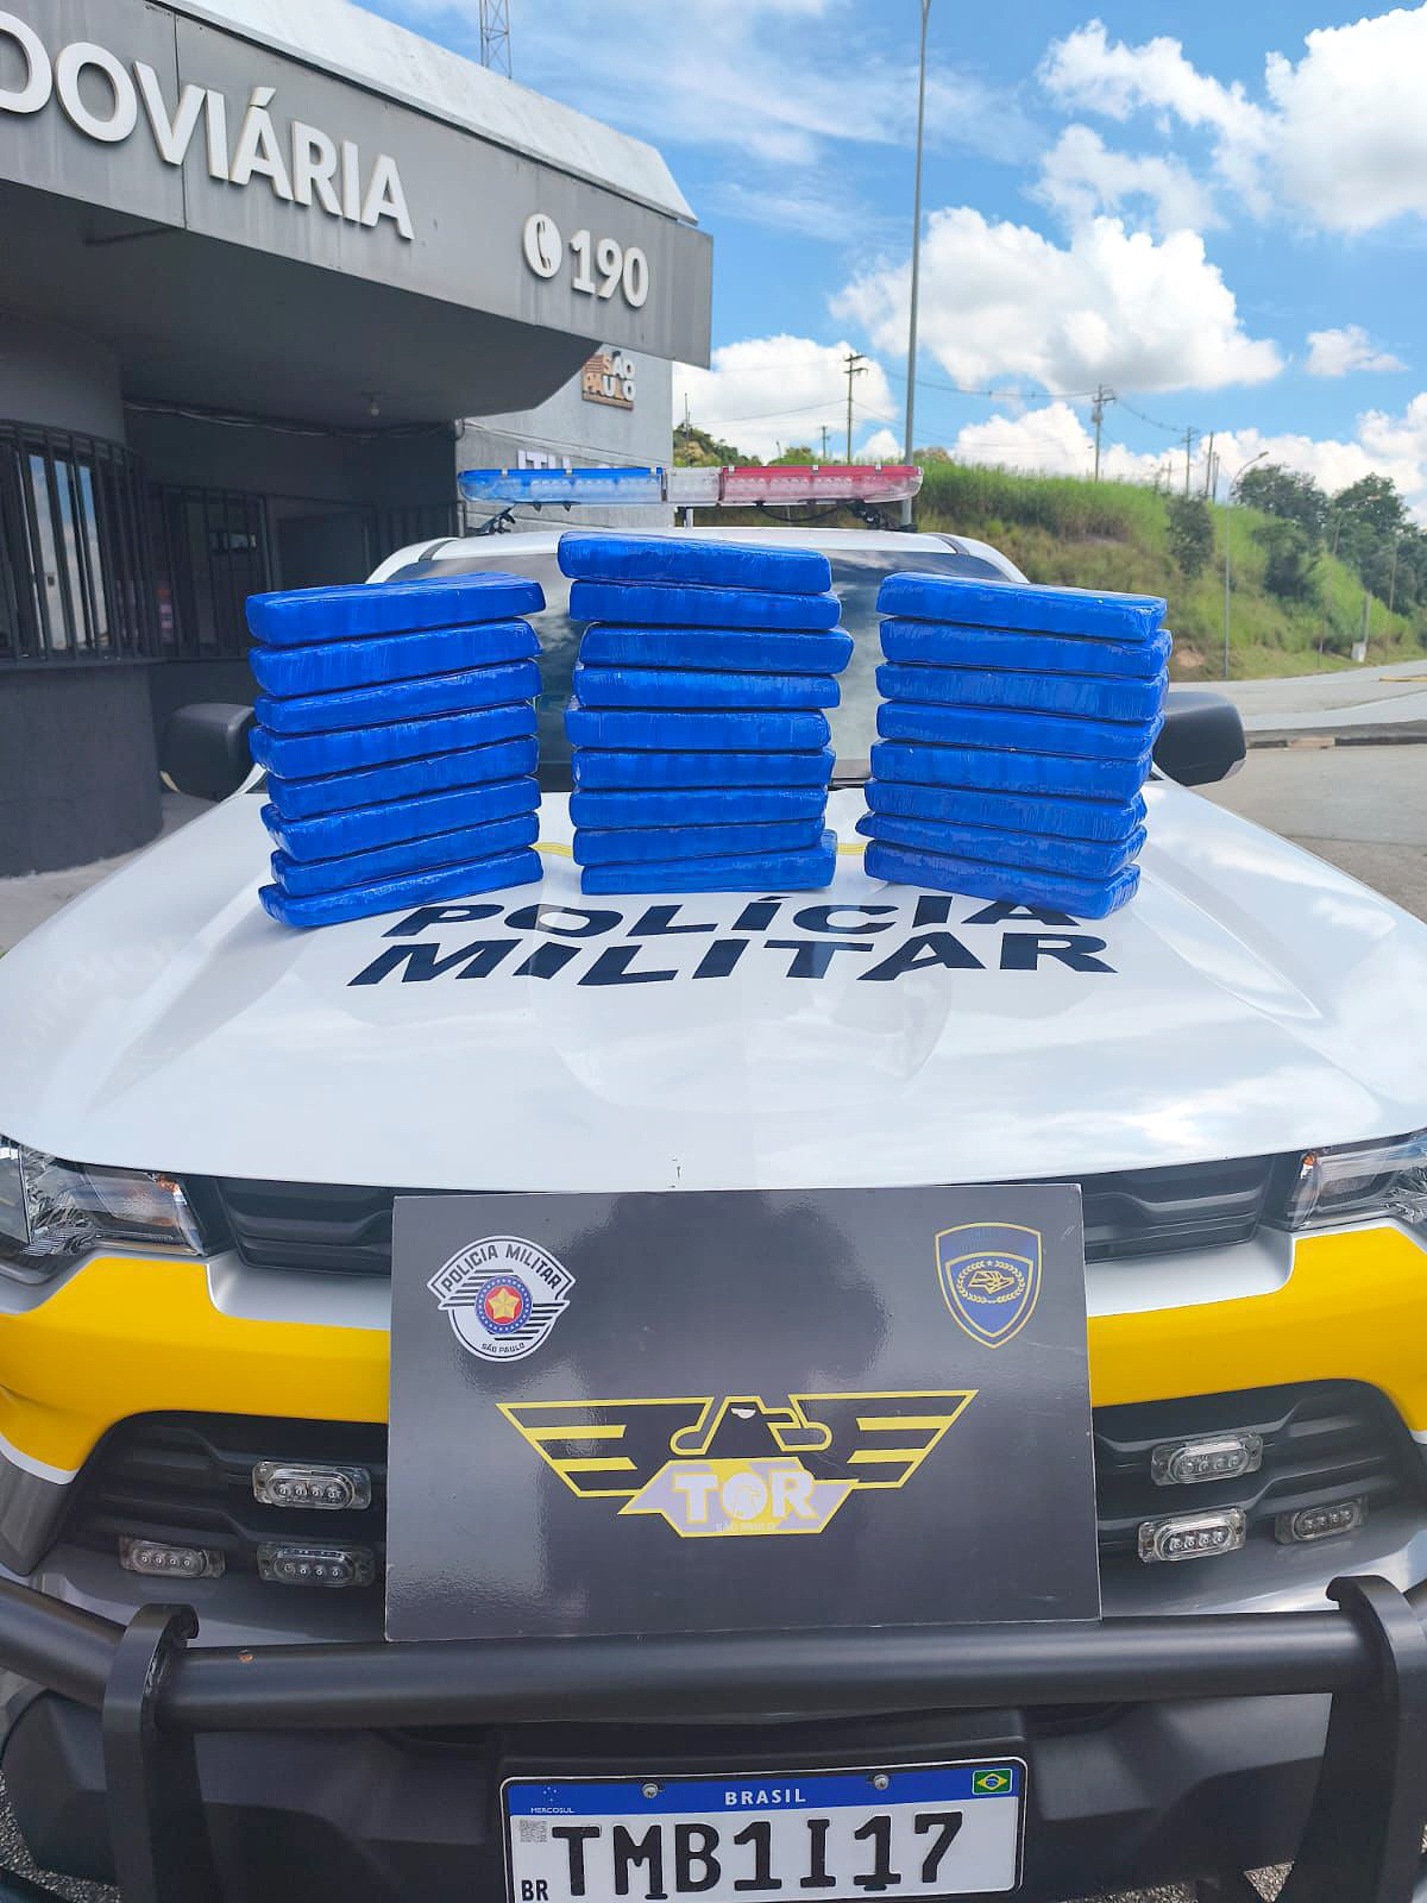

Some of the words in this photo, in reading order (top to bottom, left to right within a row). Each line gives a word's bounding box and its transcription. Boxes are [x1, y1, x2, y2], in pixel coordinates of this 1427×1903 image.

[568, 229, 649, 308] 190
[381, 895, 1081, 938] POLÍCIA
[347, 931, 1118, 986] MILITAR
[505, 1243, 562, 1290] MILITAR
[674, 1471, 818, 1521] TOR
[530, 1806, 575, 1814] MERCOSUL
[725, 1788, 806, 1806] BRASIL
[552, 1810, 963, 1899] TMB1I17
[521, 1879, 549, 1902] BR
